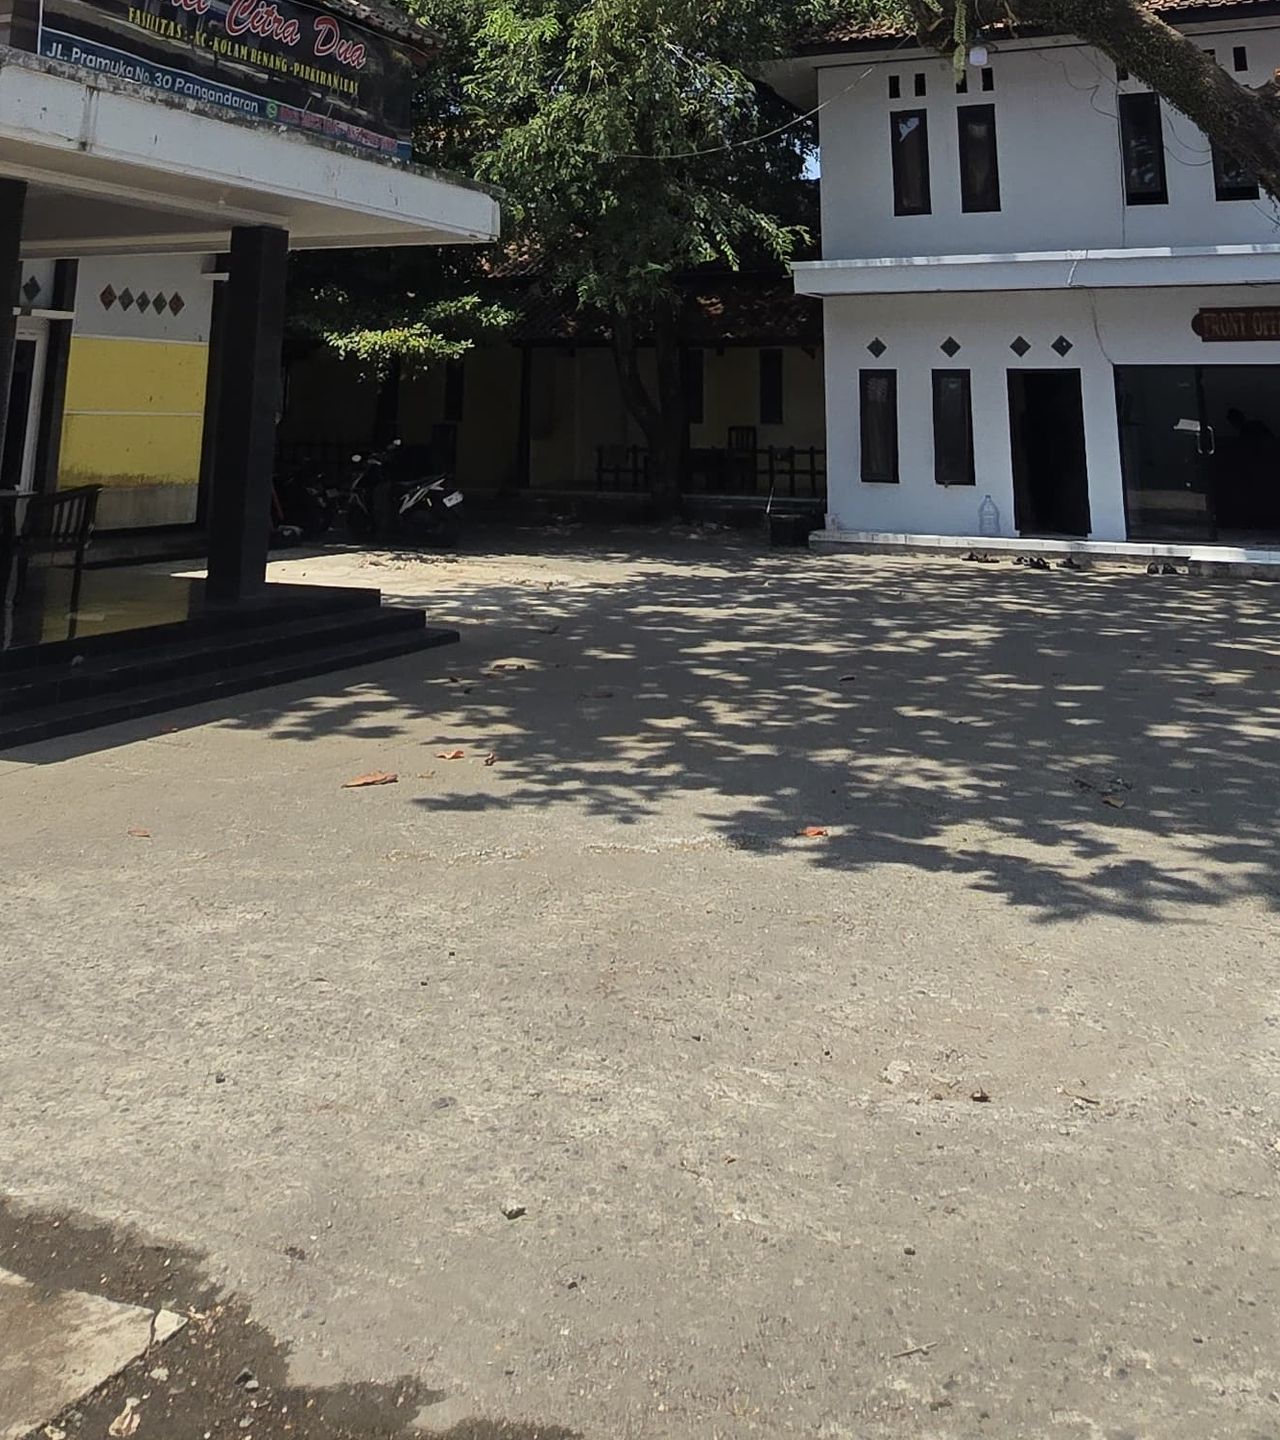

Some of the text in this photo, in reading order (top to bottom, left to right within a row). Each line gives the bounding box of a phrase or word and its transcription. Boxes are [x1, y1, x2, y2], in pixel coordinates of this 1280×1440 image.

[314, 16, 366, 69] Dua
[46, 42, 259, 113] JL. Pramuka No. 30 Pangandaran
[1203, 312, 1246, 336] FRONT
